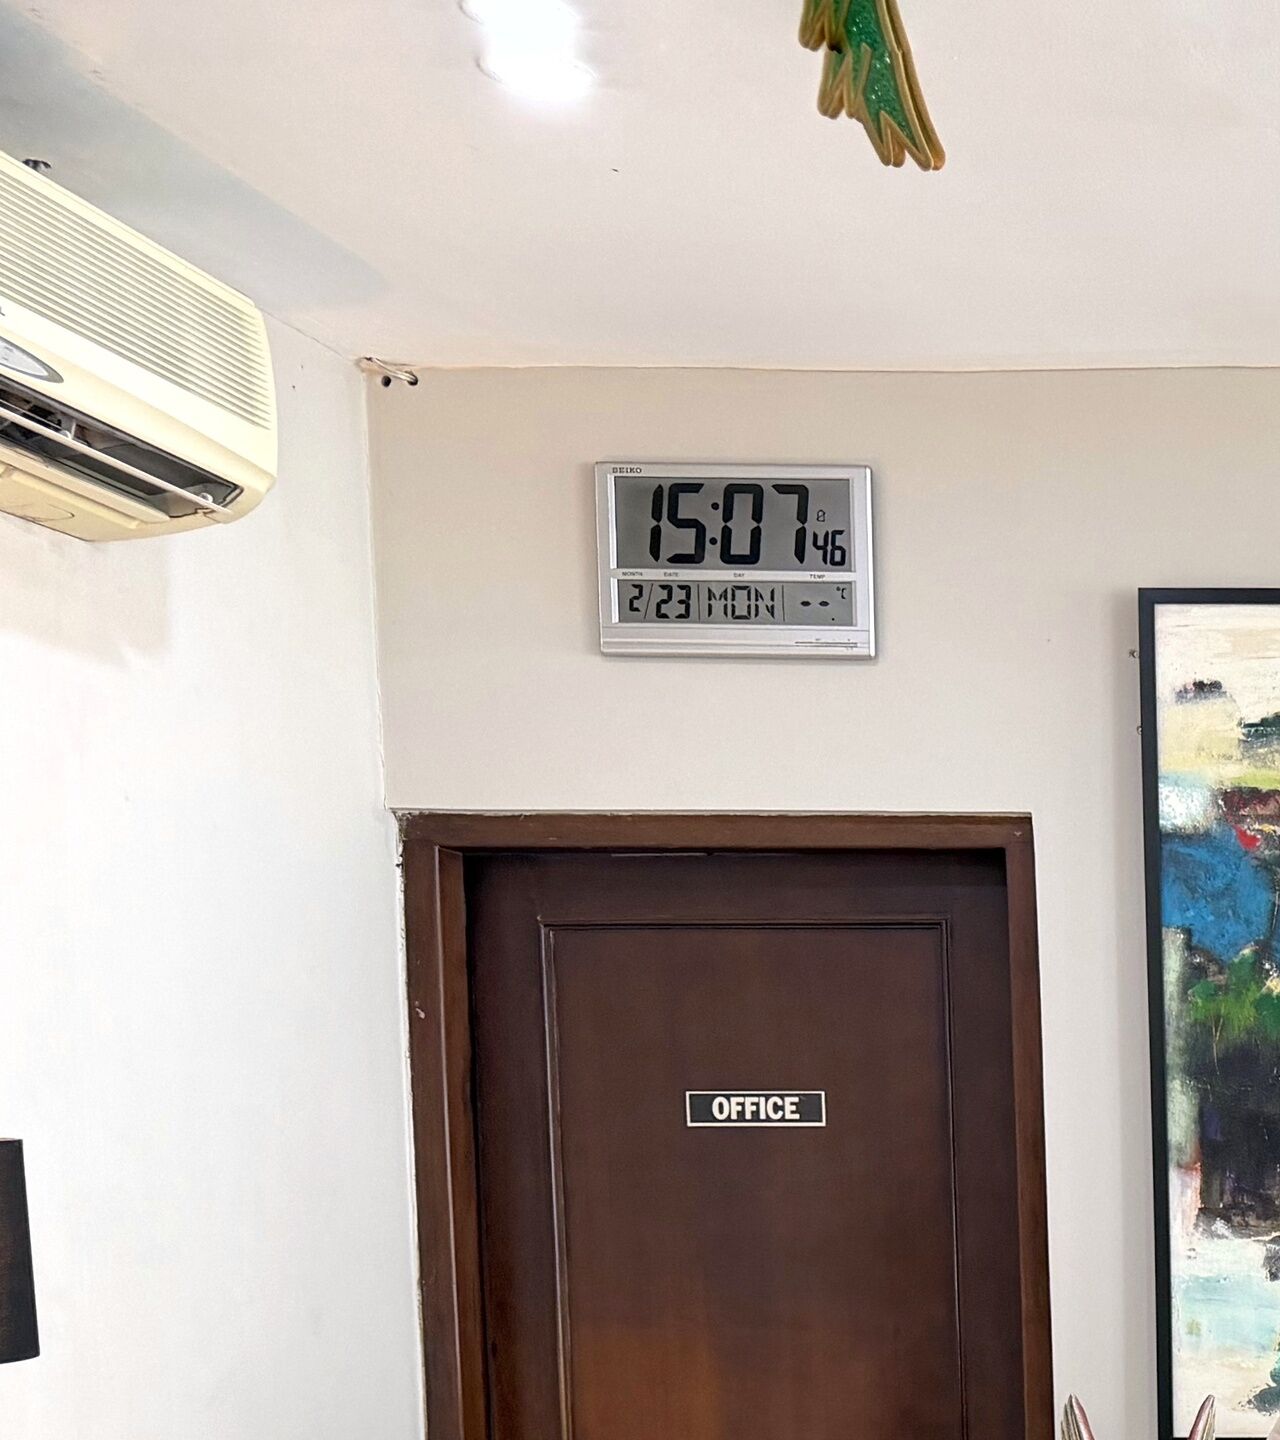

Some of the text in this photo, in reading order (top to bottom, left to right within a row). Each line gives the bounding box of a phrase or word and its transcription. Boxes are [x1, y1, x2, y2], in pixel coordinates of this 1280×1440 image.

[649, 483, 846, 566] 15:07 46
[707, 585, 775, 620] MON
[712, 1096, 800, 1120] OFFICE
